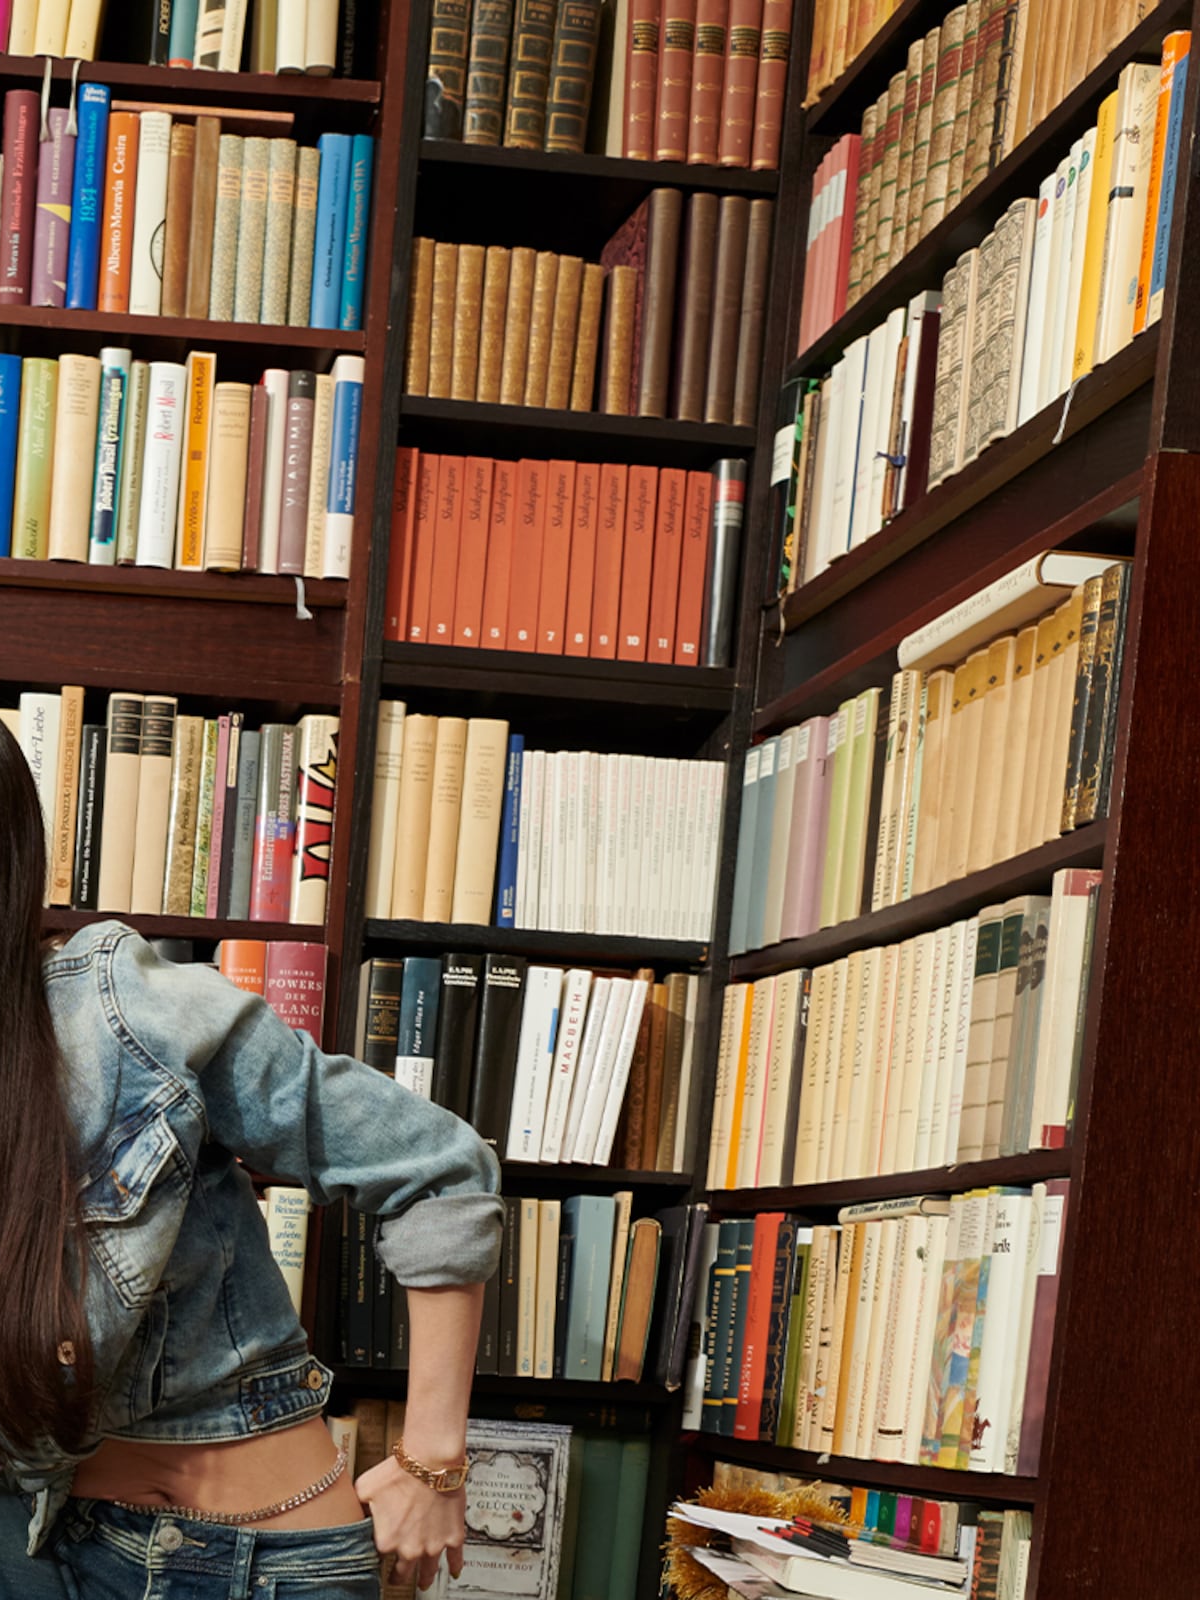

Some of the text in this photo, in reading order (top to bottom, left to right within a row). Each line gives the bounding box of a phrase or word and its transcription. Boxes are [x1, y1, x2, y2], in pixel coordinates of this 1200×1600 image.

[13, 105, 28, 178] Erzählungen
[80, 188, 97, 223] 1934
[107, 134, 128, 275] Alberto Moravia Cesira
[7, 233, 20, 279] Moravia
[193, 362, 206, 425] Robert Musil
[107, 378, 123, 444] Erzählungen
[285, 403, 301, 508] VLADIMIR
[411, 626, 421, 637] 2
[437, 623, 447, 634] 3
[463, 627, 473, 638] 4
[491, 627, 500, 638] 5
[518, 630, 528, 640] 6
[547, 631, 556, 641] 7
[574, 633, 584, 644] 8
[600, 635, 609, 645] 9
[627, 635, 640, 647] 10
[658, 638, 668, 648] 11
[682, 642, 695, 653] 12
[278, 732, 293, 840] an BORIS PASTERNAK
[262, 810, 276, 881] Erinnerungen
[268, 978, 322, 991] POWERS
[285, 993, 307, 1001] DER
[412, 990, 425, 1054] Edgar Allan Poe
[561, 993, 583, 1074] MACBETH
[476, 1500, 526, 1512] GLÜCKS
